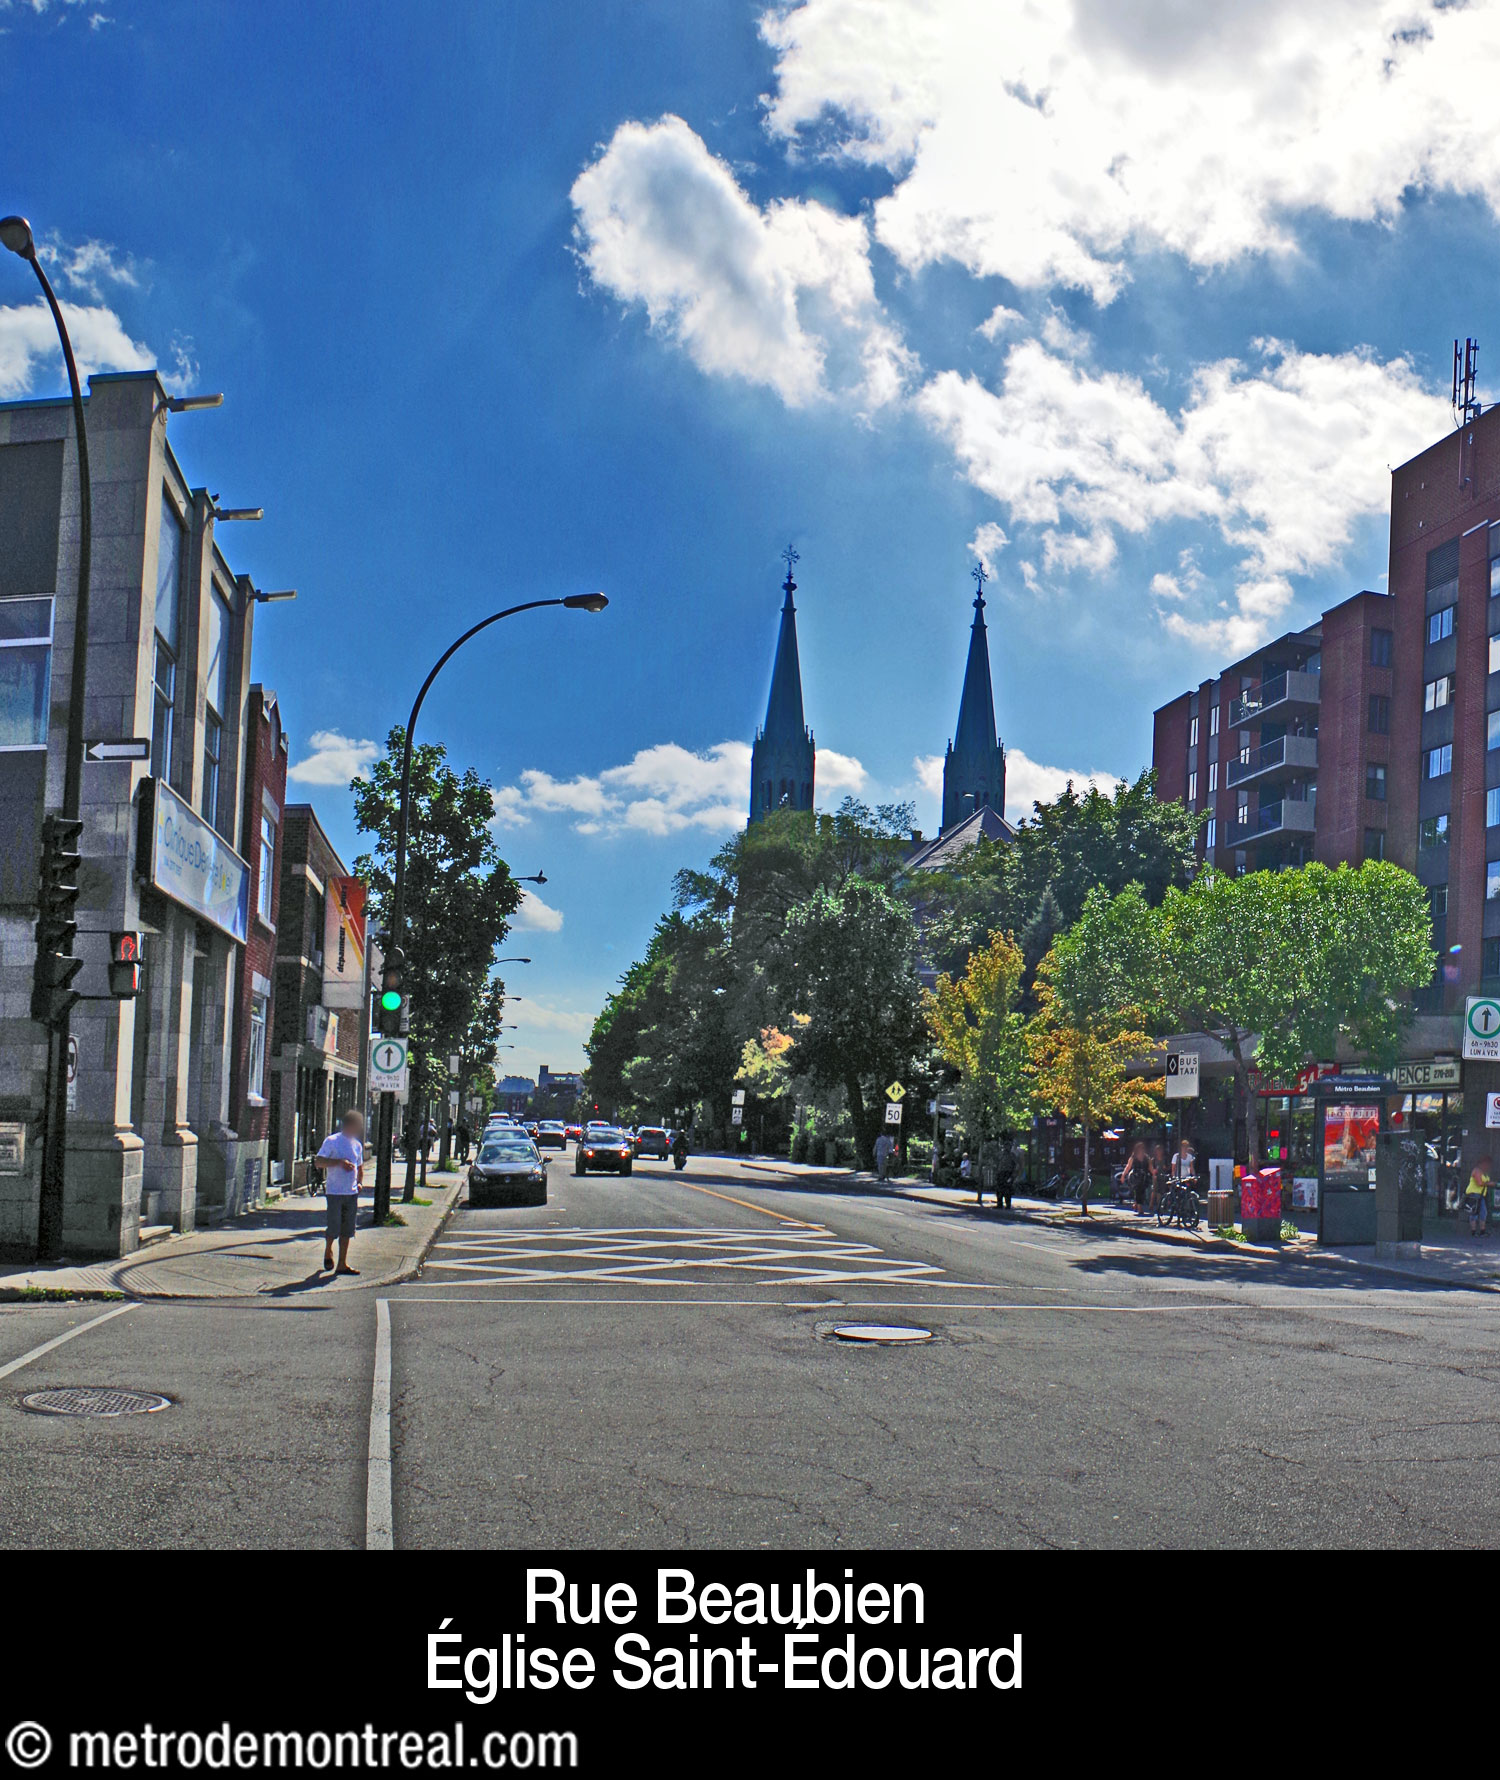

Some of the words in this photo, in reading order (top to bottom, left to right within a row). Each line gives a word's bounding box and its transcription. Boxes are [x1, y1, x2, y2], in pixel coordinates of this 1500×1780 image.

[1179, 1057, 1198, 1066] BUS
[1334, 1085, 1353, 1093] Métro
[1354, 1085, 1381, 1093] Beaubien
[888, 1109, 900, 1120] 50
